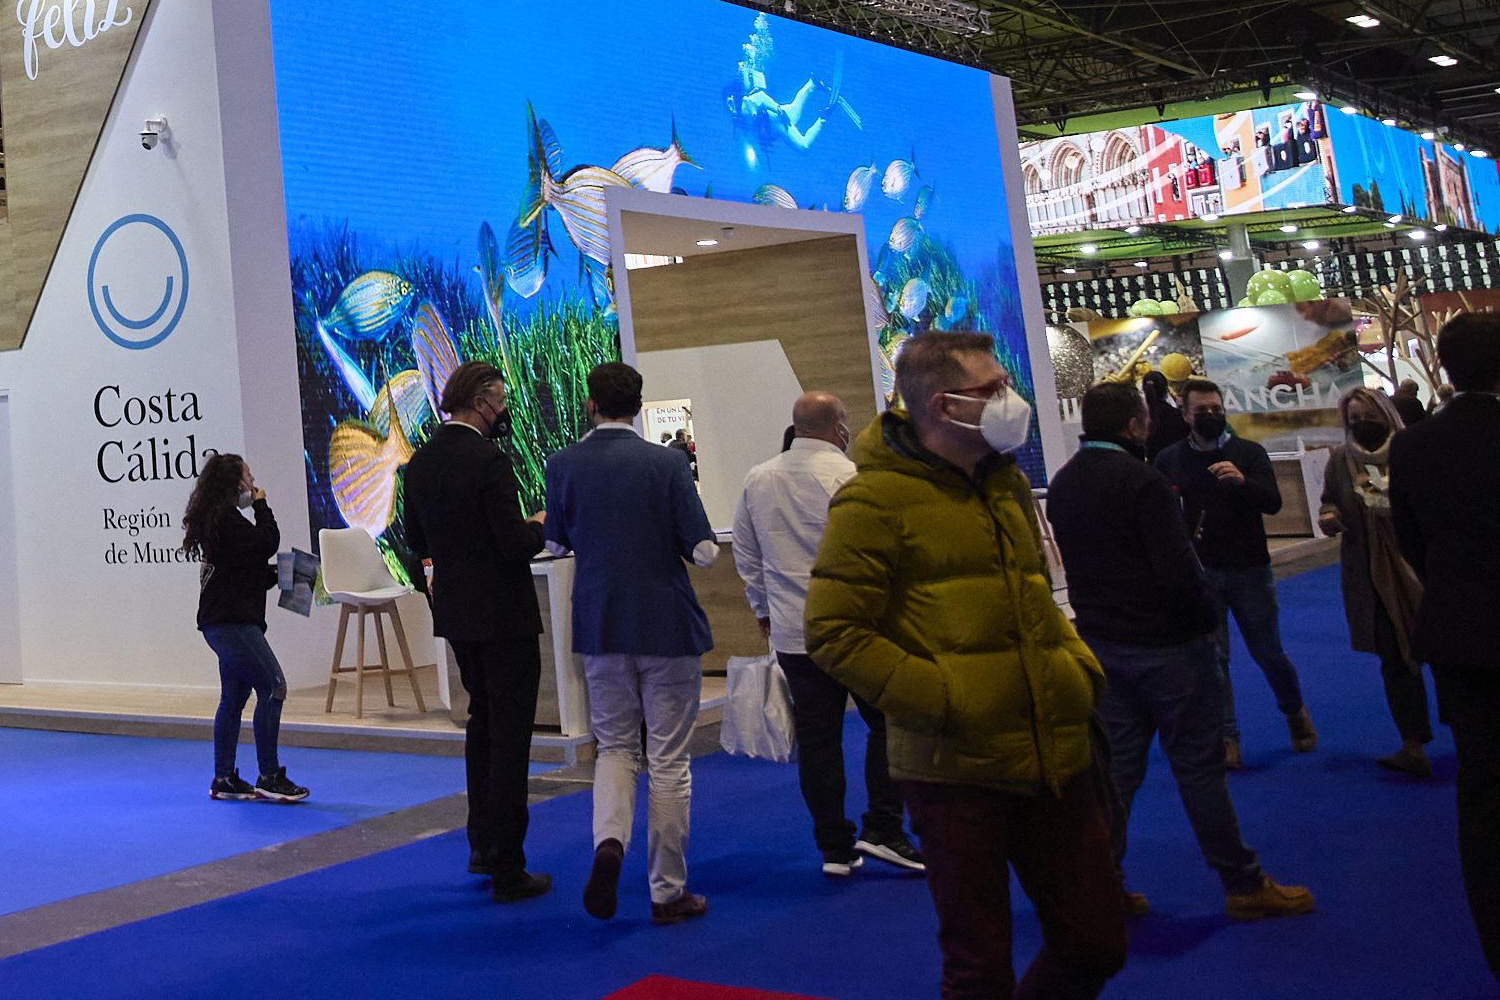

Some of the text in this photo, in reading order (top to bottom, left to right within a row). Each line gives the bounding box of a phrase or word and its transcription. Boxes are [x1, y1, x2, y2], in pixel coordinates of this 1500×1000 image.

[94, 384, 203, 427] Costa
[1224, 382, 1343, 413] ANCHA
[102, 506, 171, 537] Región
[105, 542, 128, 564] de
